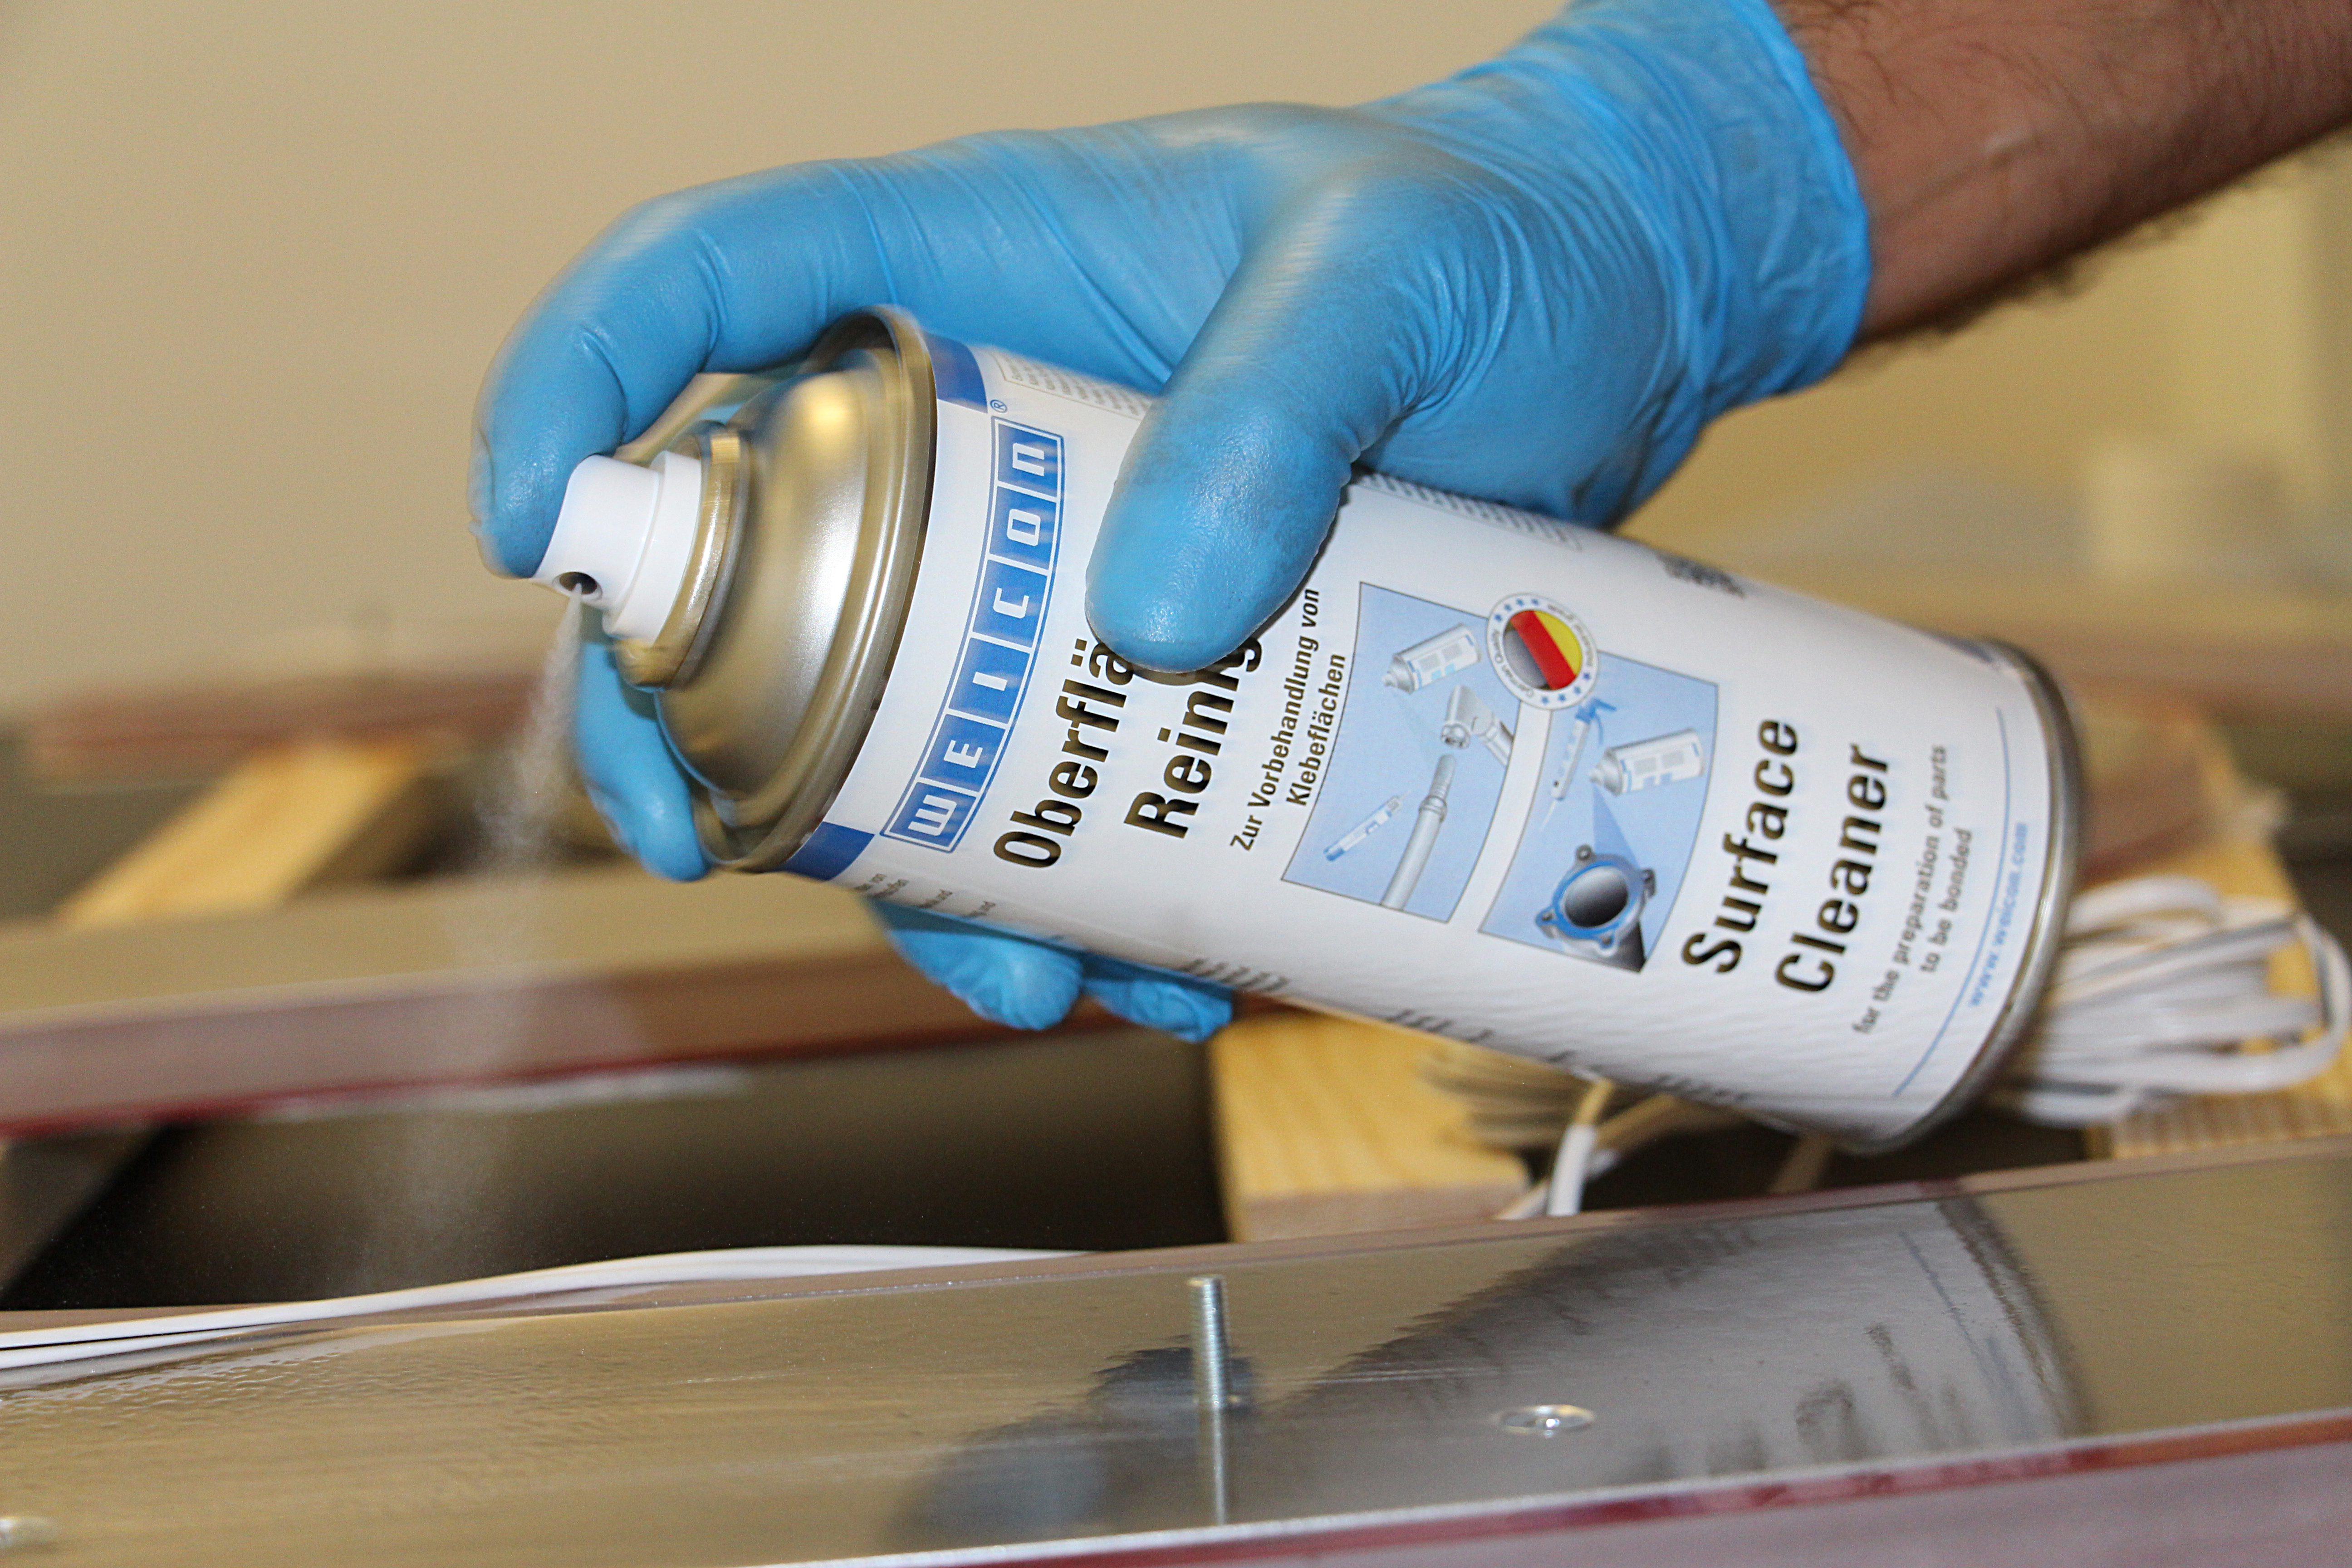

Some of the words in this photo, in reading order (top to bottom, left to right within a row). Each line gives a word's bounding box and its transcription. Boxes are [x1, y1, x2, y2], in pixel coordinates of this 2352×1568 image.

[1230, 814, 1263, 851] Zur
[1247, 635, 1319, 807] Vorbehandlung
[1301, 588, 1320, 627] von
[1285, 654, 1346, 806] Klebeflächen
[1931, 745, 1950, 801] parts
[1681, 719, 1799, 974] Surface
[1925, 803, 1944, 828] of
[1774, 743, 1889, 993] Cleaner
[1892, 835, 1940, 965] preparation
[1938, 827, 1973, 912] bonded
[1919, 952, 1941, 973] to
[1927, 918, 1952, 946] be
[1851, 1006, 1881, 1034] for
[1872, 970, 1900, 1002] the
